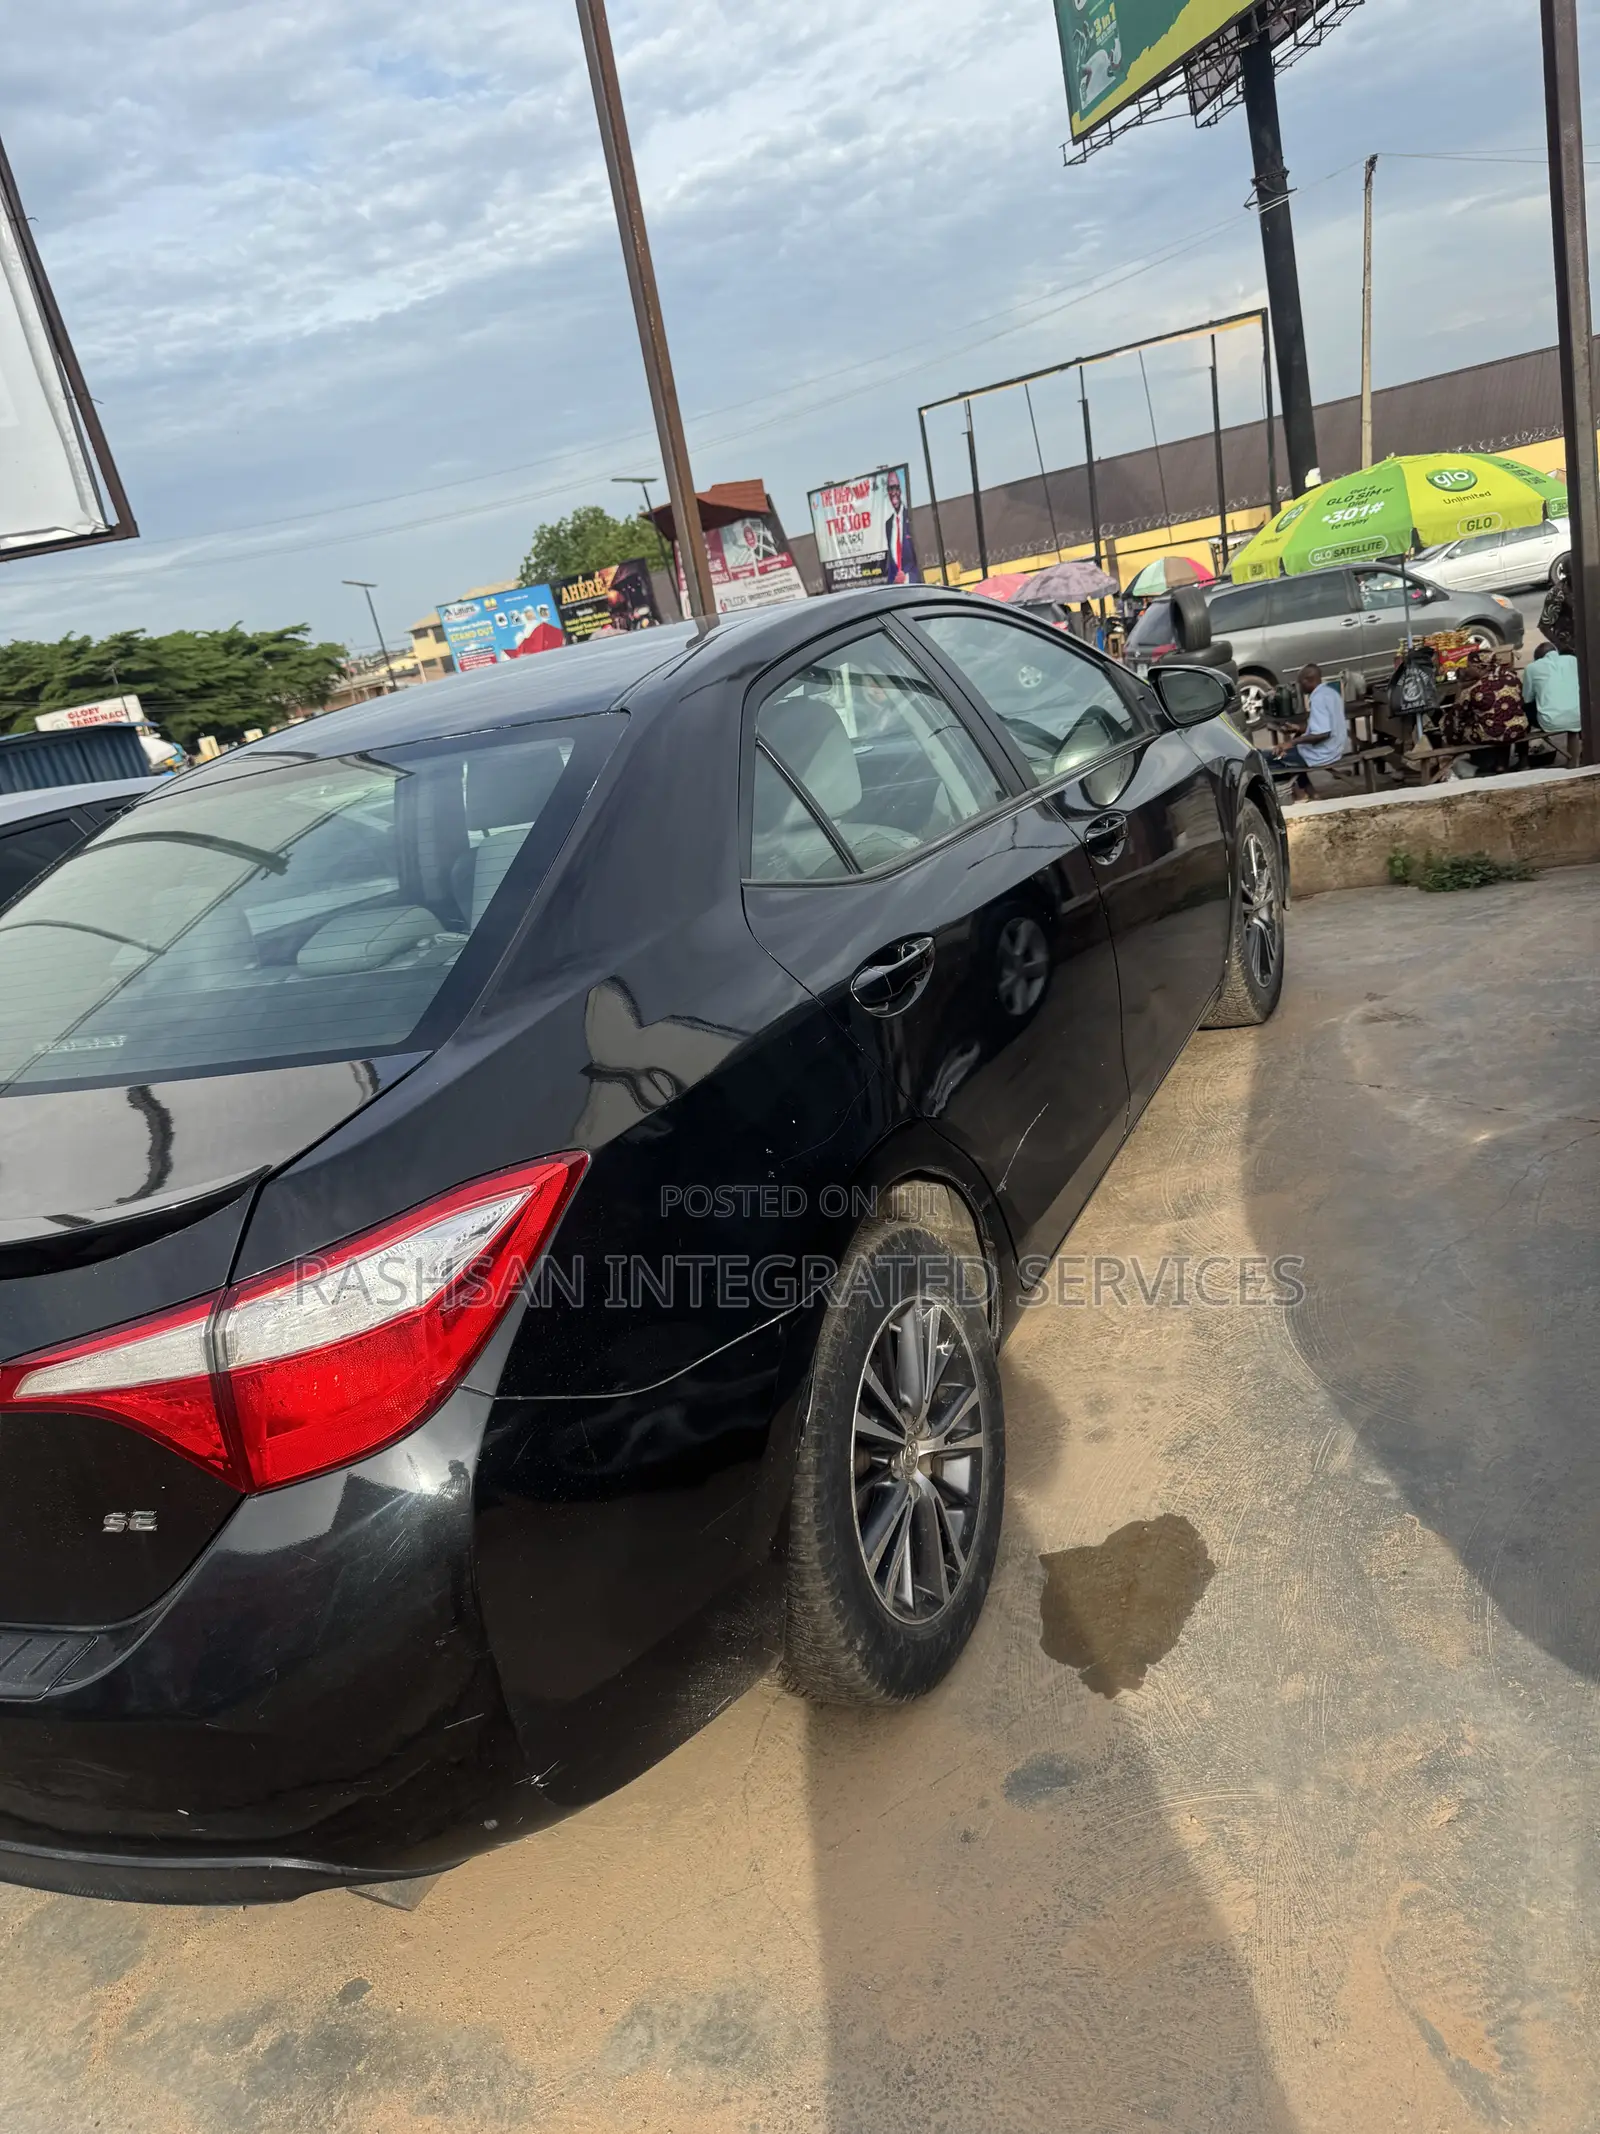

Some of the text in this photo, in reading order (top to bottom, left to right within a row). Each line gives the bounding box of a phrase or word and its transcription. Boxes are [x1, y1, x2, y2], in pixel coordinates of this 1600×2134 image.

[1433, 470, 1470, 488] glo
[1326, 493, 1356, 507] GLO
[1355, 488, 1383, 500] SIM
[1347, 498, 1369, 508] Dial
[1442, 490, 1492, 505] Unlimited
[848, 511, 871, 532] JOB
[1330, 517, 1370, 531] to enjoy
[1465, 516, 1493, 532] GLO
[1312, 540, 1384, 562] GLO SATELLITE
[102, 1510, 158, 1533] SE
